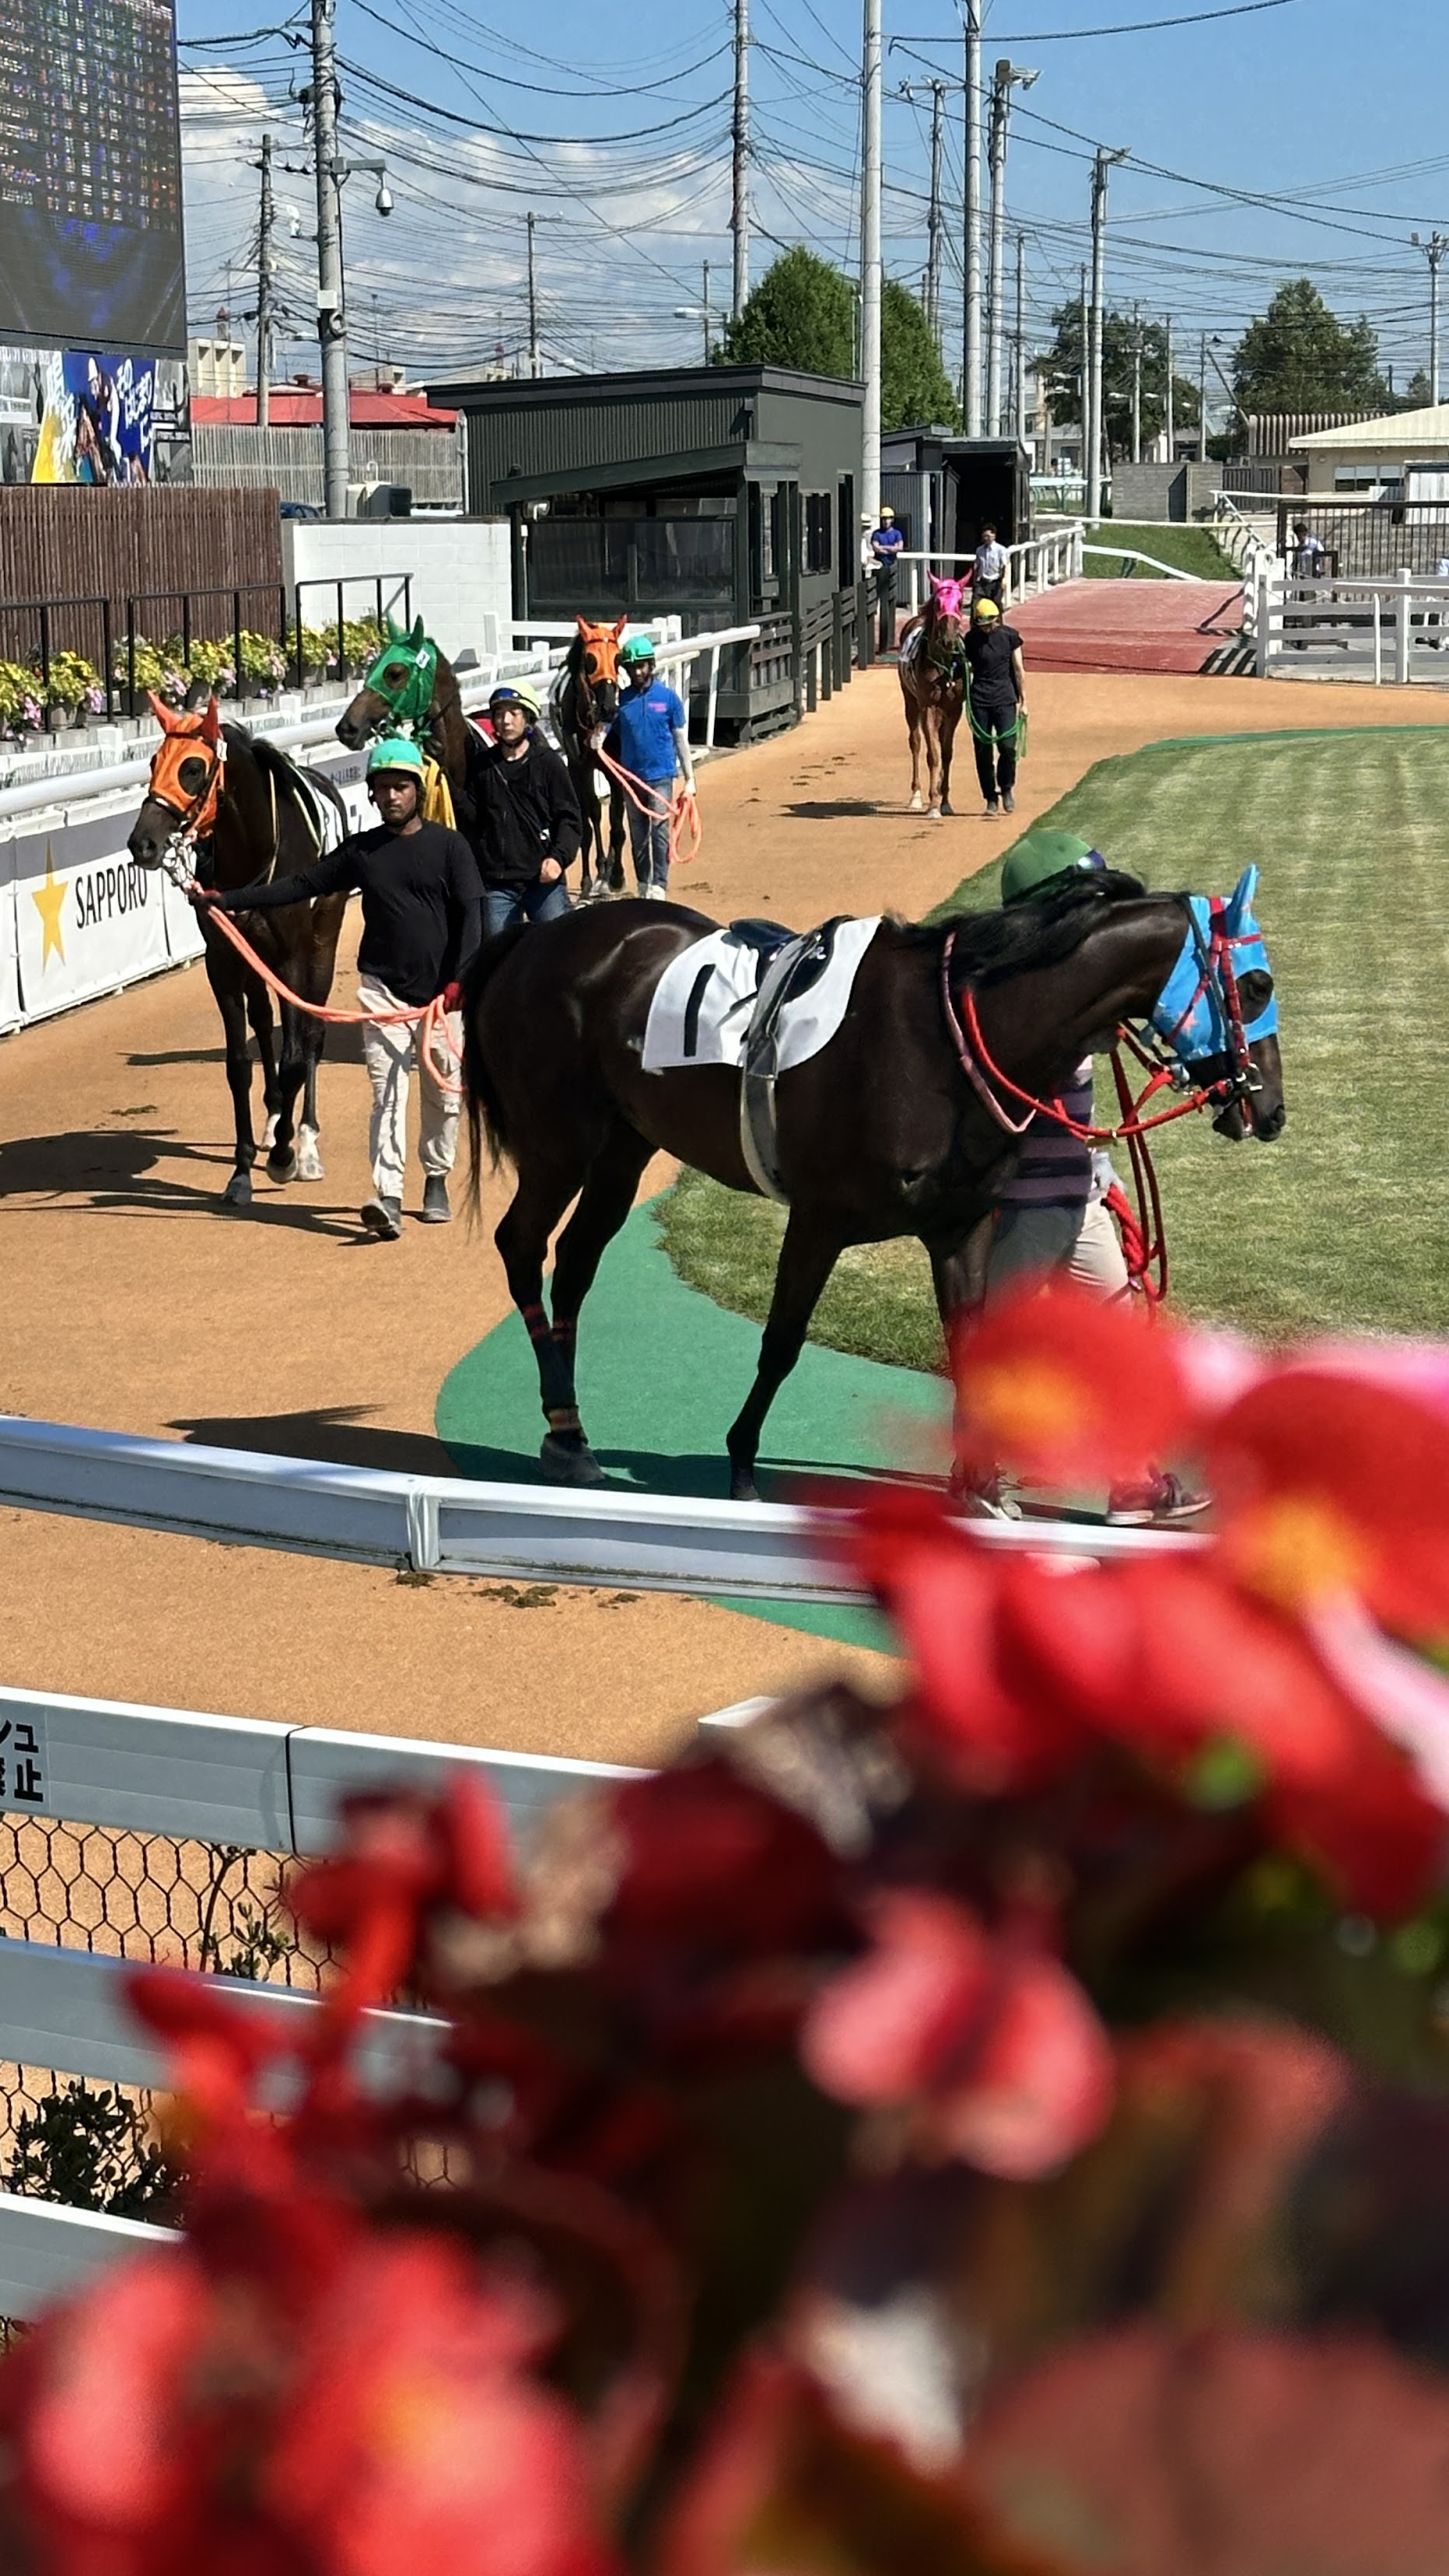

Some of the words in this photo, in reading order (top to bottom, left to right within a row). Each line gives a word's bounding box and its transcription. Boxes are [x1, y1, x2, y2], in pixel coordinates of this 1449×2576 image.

[75, 862, 148, 929] SAPPORO
[684, 964, 716, 1058] 1
[0, 1757, 44, 1803] 止
